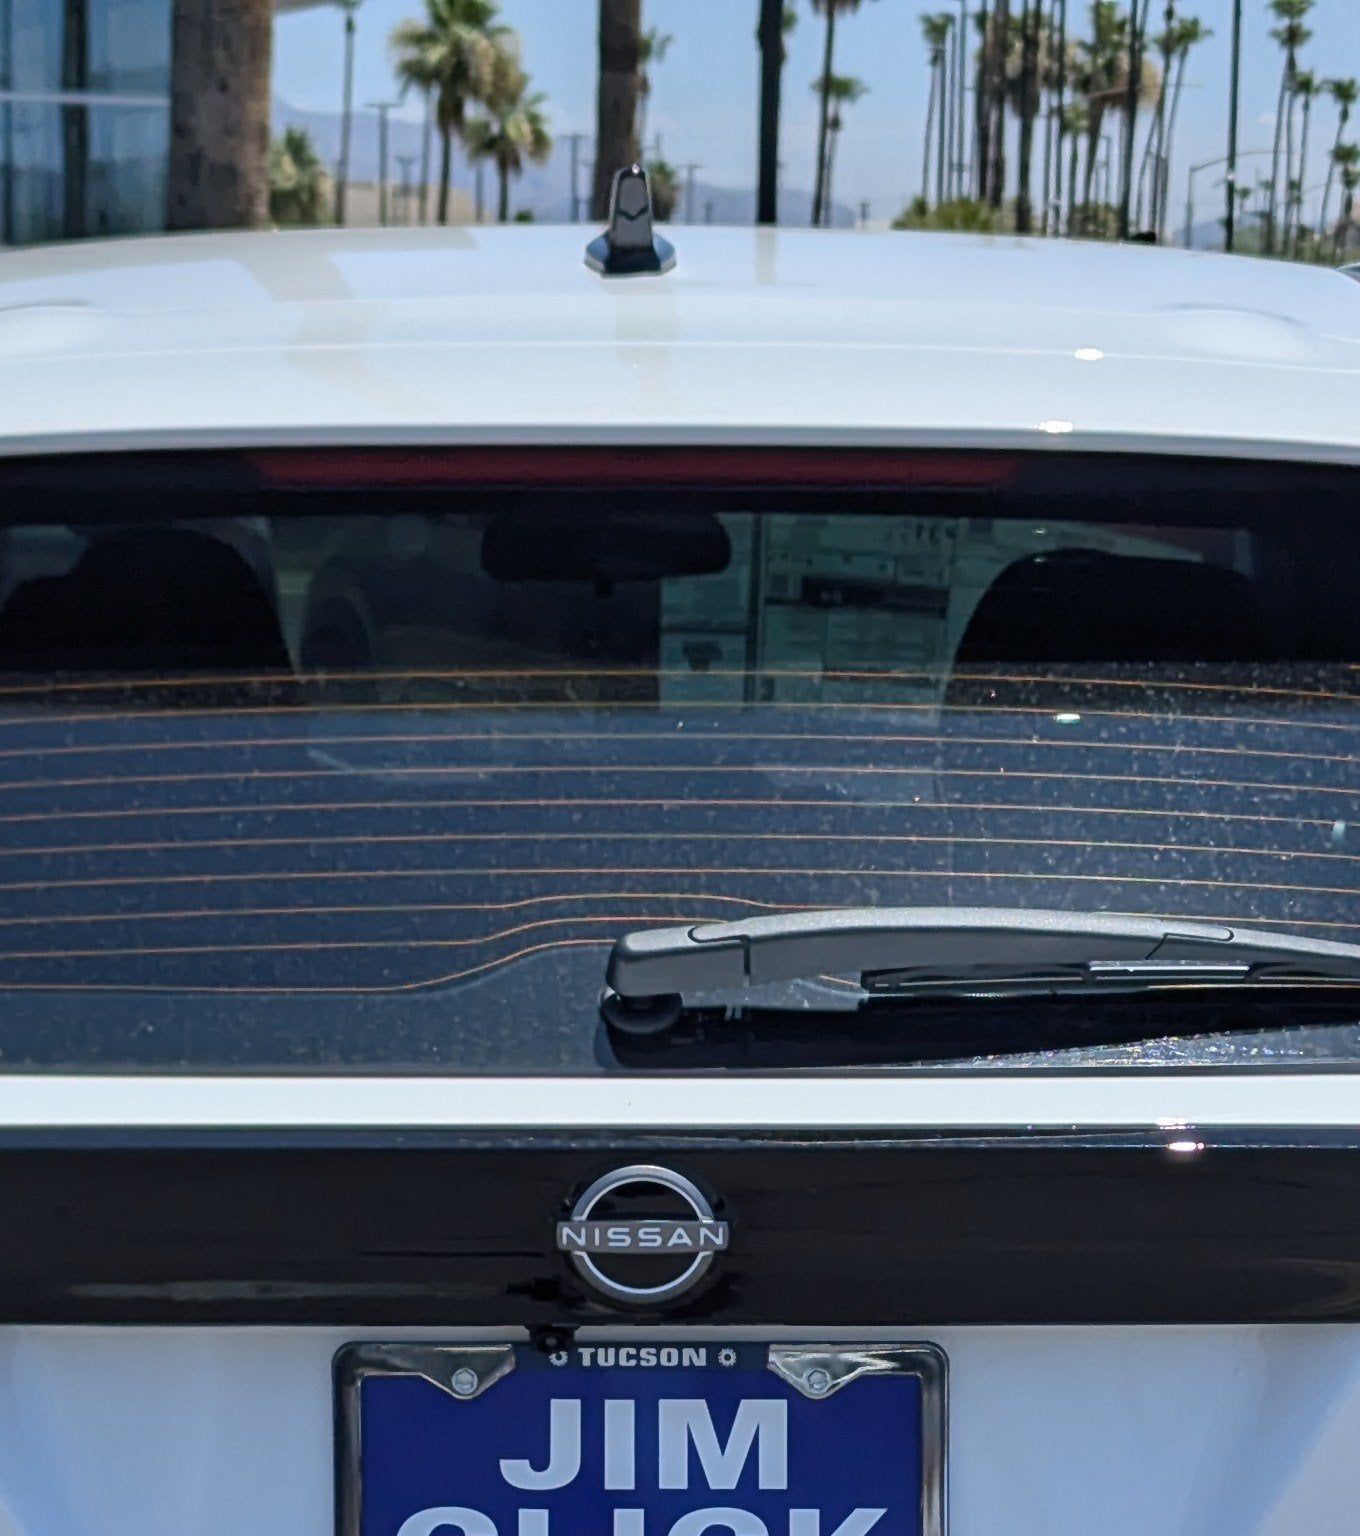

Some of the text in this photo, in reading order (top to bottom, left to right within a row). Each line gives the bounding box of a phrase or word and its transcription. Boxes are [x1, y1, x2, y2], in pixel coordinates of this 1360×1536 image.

[562, 1225, 727, 1248] NISSAN
[578, 1348, 707, 1368] TUCSON
[499, 1399, 788, 1491] JIM
